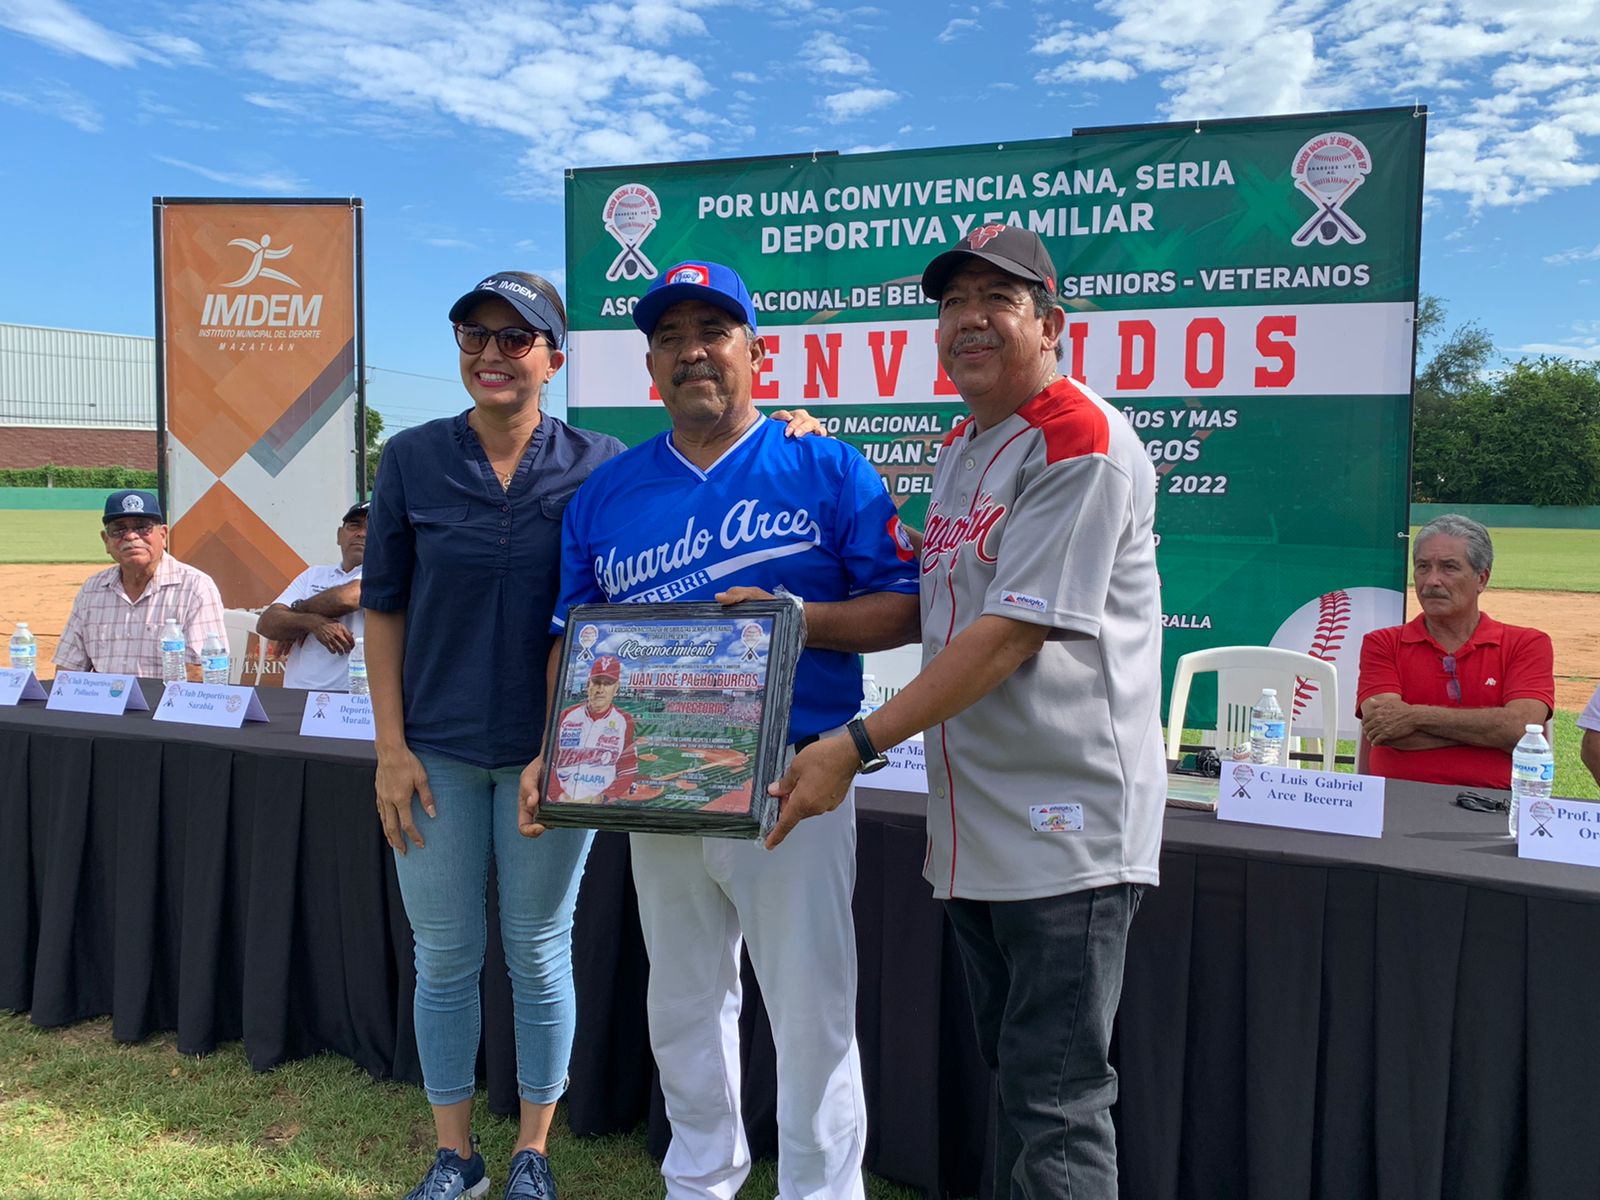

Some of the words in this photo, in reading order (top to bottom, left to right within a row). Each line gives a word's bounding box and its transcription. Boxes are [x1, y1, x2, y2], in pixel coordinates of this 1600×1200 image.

[698, 194, 753, 219] POR
[760, 190, 819, 216] UNA
[824, 173, 1026, 213] CONVIVENCIA
[1032, 168, 1126, 198] SANA,
[1136, 160, 1235, 190] SERIA
[761, 216, 947, 254] DEPORTIVA
[952, 214, 976, 240] Y
[499, 281, 537, 301] IMDEM
[752, 288, 847, 311] ACIONAL
[851, 287, 881, 308] DE
[1063, 271, 1176, 298] SENIORS
[1200, 264, 1370, 291] VETERANOS
[201, 294, 323, 327] IMDEM
[199, 329, 235, 338] INSTITUTO
[236, 329, 273, 338] MUNICIPAL
[274, 330, 287, 338] DEL
[288, 330, 321, 339] DEPORTE
[650, 315, 1297, 400] ENVIDOS
[844, 415, 942, 434] NACIONAL
[1121, 406, 1165, 428] ÑOS
[1170, 410, 1186, 428] Y
[1188, 409, 1238, 428] MAS
[862, 443, 922, 464] JUAN
[1146, 439, 1201, 461] GOS
[897, 476, 934, 493] DEL
[1168, 475, 1228, 493] 2022
[594, 516, 714, 598] Eduardo
[719, 499, 820, 549] Arce
[632, 570, 712, 603] CERRA
[1161, 613, 1212, 629] RALLA
[618, 639, 717, 660] Reconocimiento
[628, 672, 652, 687] JUAN
[655, 670, 678, 687] JOSÉ
[681, 672, 716, 687] PACHO
[718, 673, 758, 689] BURGOS
[180, 689, 196, 697] Club
[197, 690, 230, 700] Deportivo
[351, 696, 369, 705] Club
[342, 716, 370, 725] Muralla
[1260, 770, 1273, 783] C.
[1281, 773, 1308, 786] Luis
[1315, 776, 1363, 792] Gabriel
[1267, 788, 1297, 802] Arce
[1304, 792, 1353, 808] Becerra
[1557, 807, 1591, 822] Prof.
